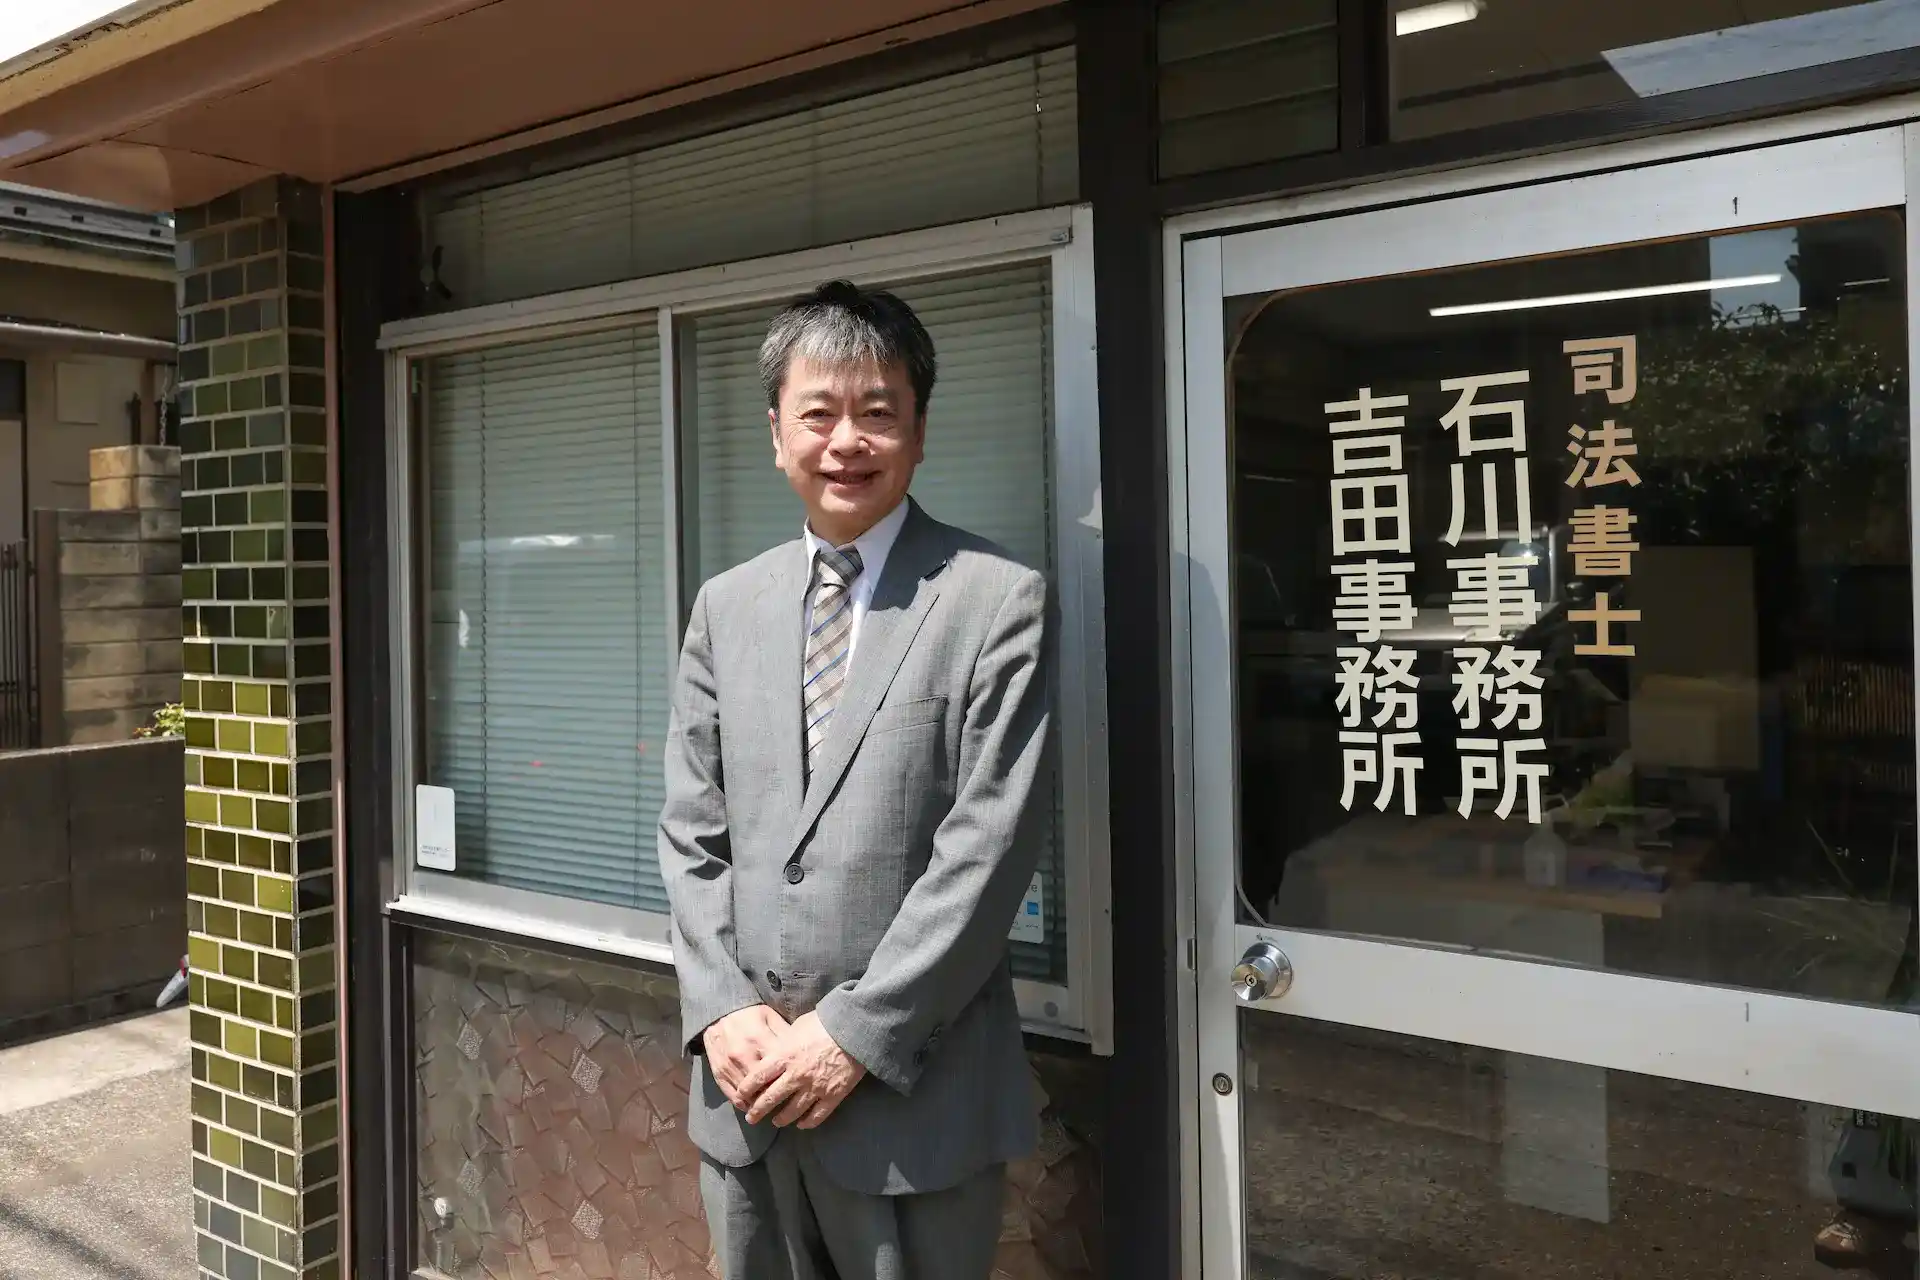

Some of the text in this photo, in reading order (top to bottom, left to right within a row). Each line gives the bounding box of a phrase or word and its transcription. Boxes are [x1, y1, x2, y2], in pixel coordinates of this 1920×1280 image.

[1324, 387, 1424, 816] 吉田事務所
[1439, 369, 1549, 824] 石川事務所
[1562, 334, 1642, 657] 司法書士
